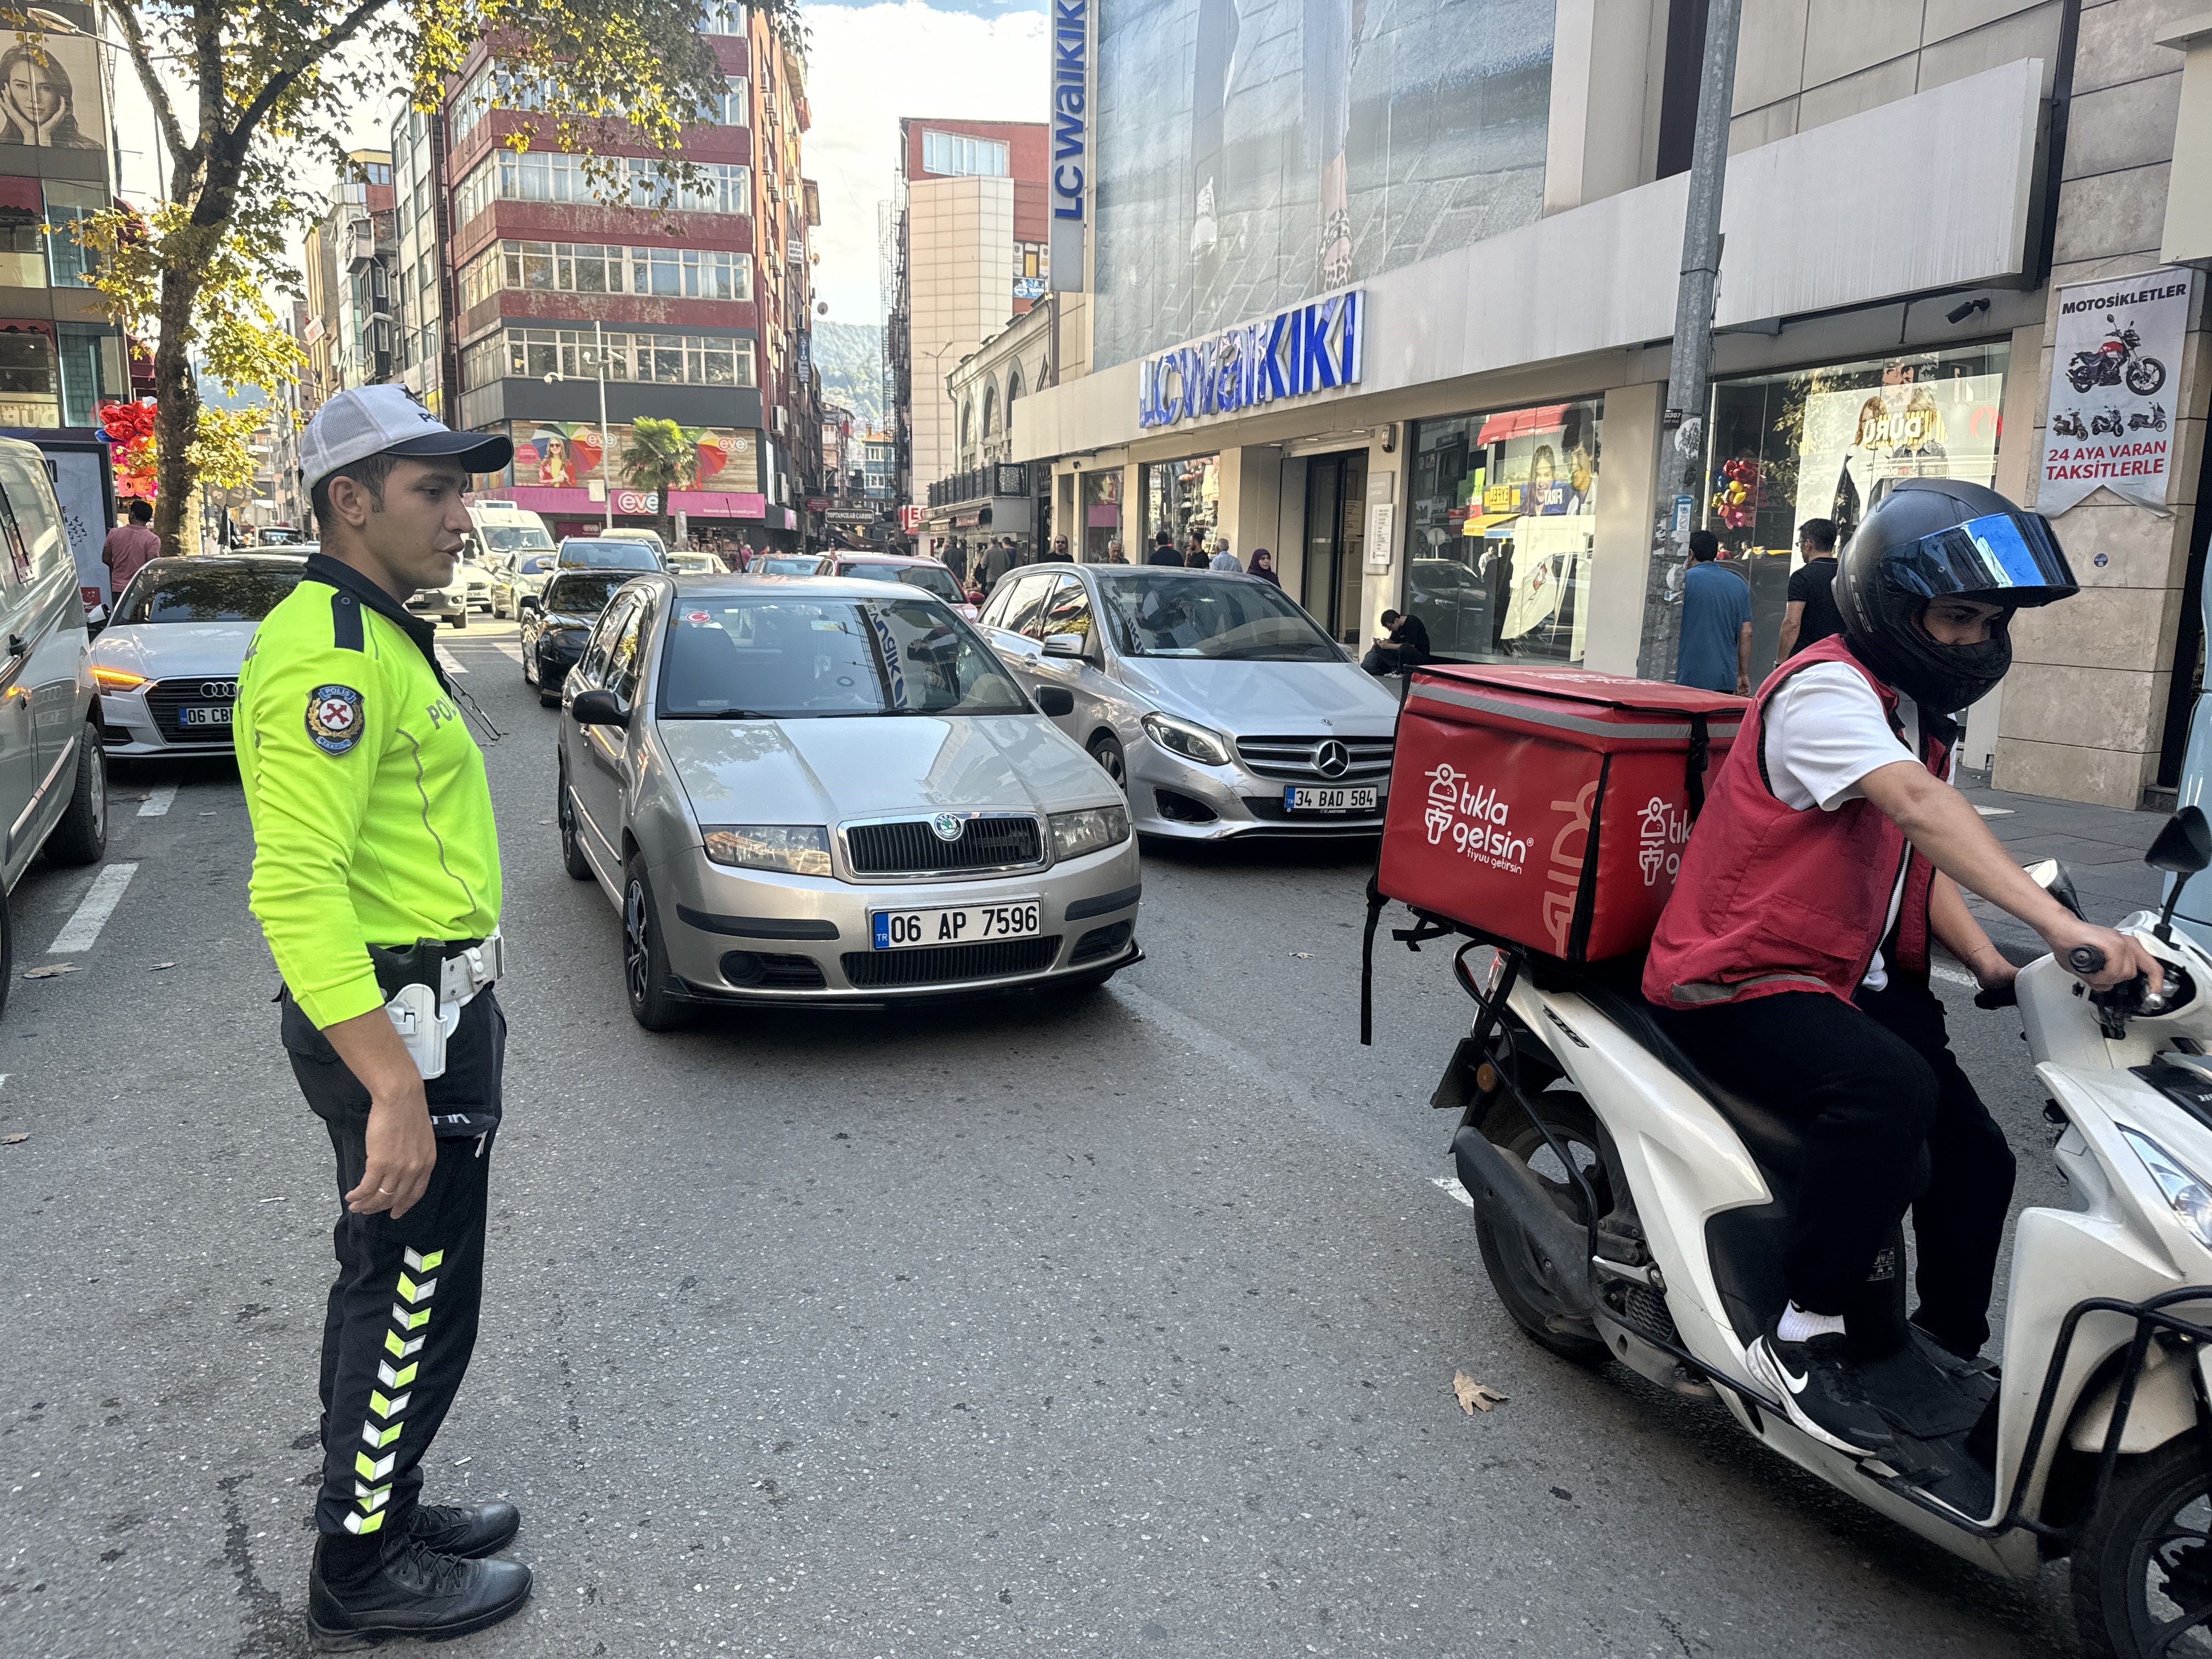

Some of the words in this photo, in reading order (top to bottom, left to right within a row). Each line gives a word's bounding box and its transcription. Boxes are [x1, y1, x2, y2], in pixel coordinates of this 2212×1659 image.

[2062, 283, 2187, 315] MOTOSİKLETLER
[718, 437, 748, 452] eve
[2048, 449, 2069, 462] 24
[2073, 445, 2105, 460] AYA
[2109, 440, 2167, 458] VARAN
[2046, 458, 2165, 481] TAKSİTLERLE
[188, 709, 206, 723] 06
[1295, 791, 1312, 806] 34
[1319, 791, 1344, 806] BAD
[1351, 789, 1373, 806] 584
[1466, 847, 1489, 864] fiyuu
[1491, 857, 1522, 875] getirsin
[890, 915, 921, 943] 06
[939, 911, 966, 940] AP
[982, 906, 1037, 936] 7596
[877, 933, 888, 942] TR
